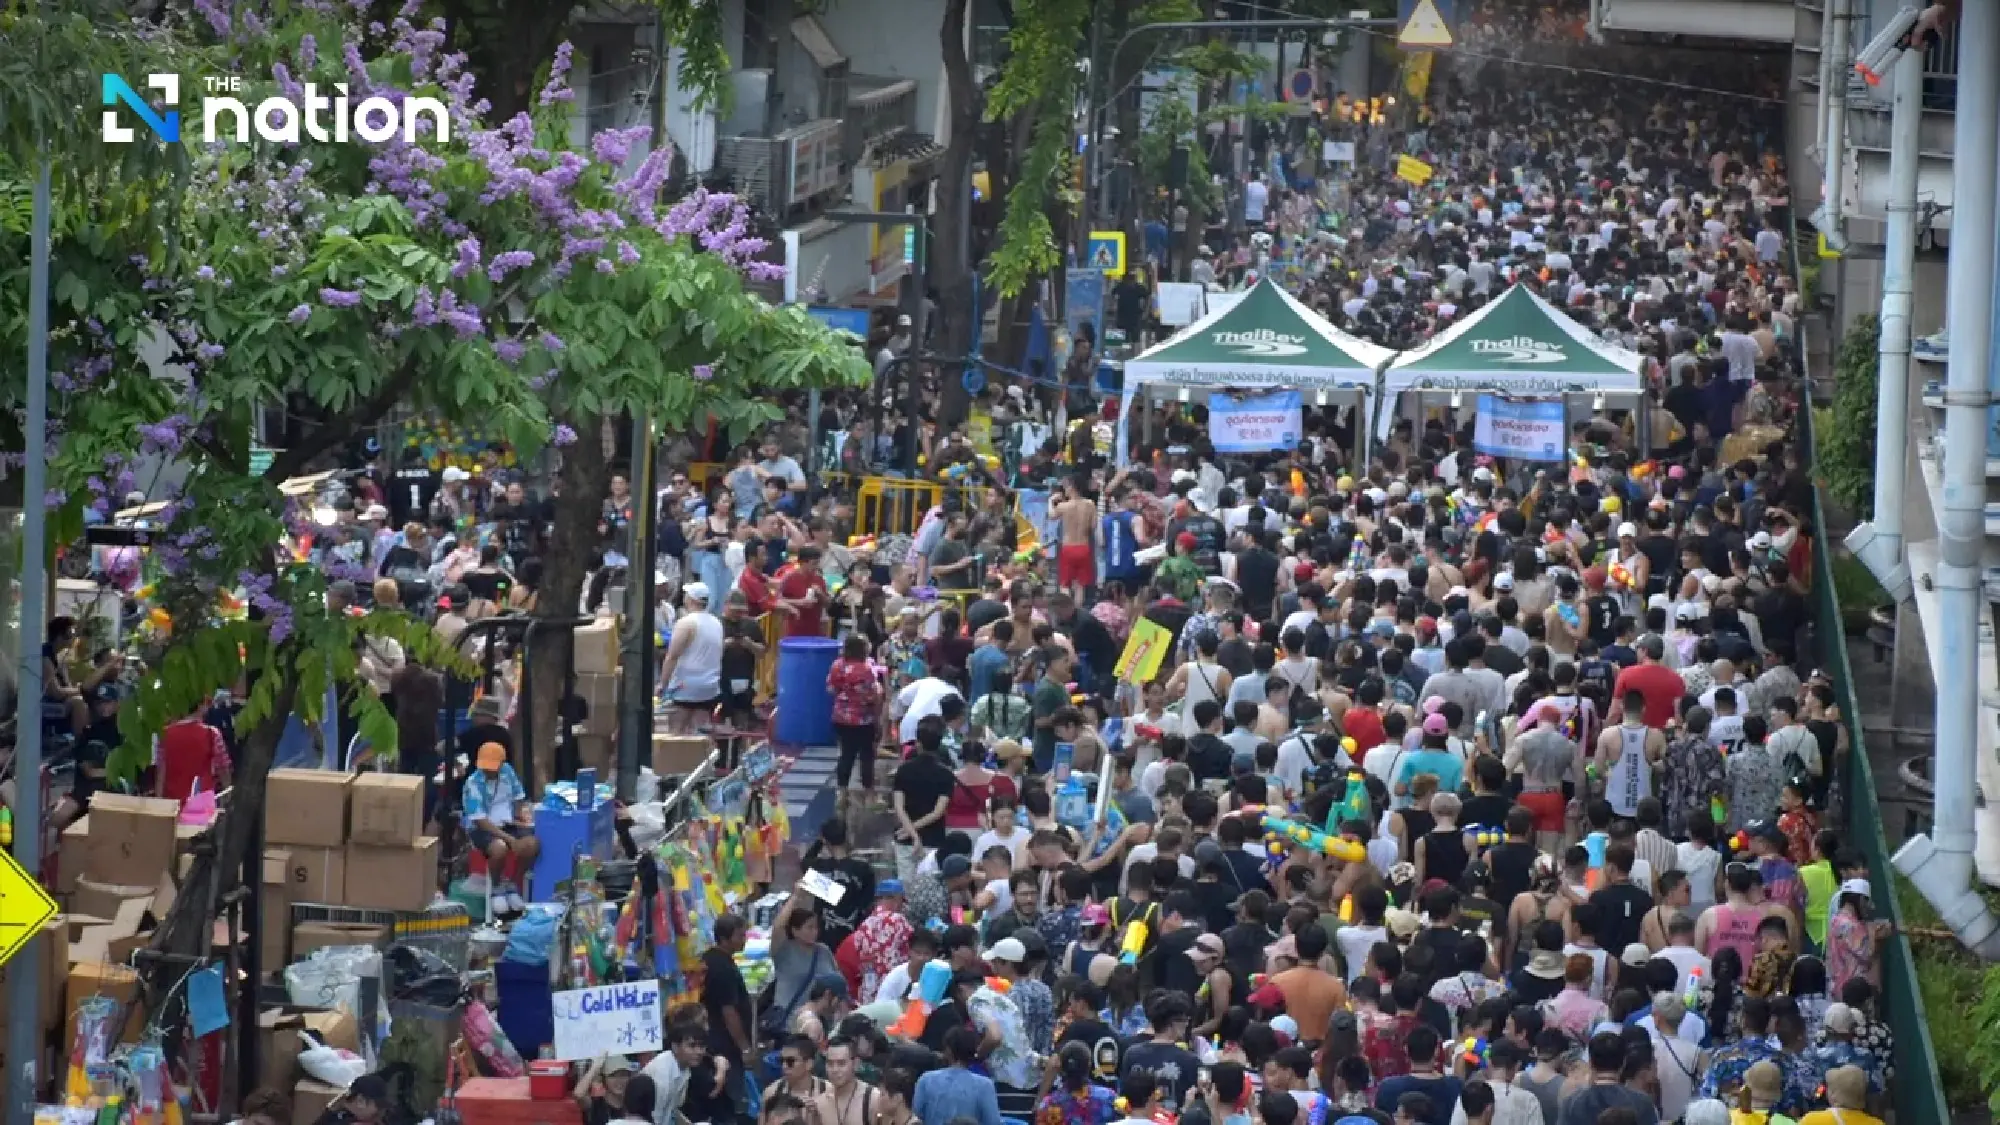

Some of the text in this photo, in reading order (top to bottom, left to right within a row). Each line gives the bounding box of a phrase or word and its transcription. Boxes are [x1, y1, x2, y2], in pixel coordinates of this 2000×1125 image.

[1212, 328, 1306, 346] ThaiBev
[1469, 335, 1563, 352] ThaiBev
[294, 866, 307, 883] S
[582, 987, 613, 1014] Cold
